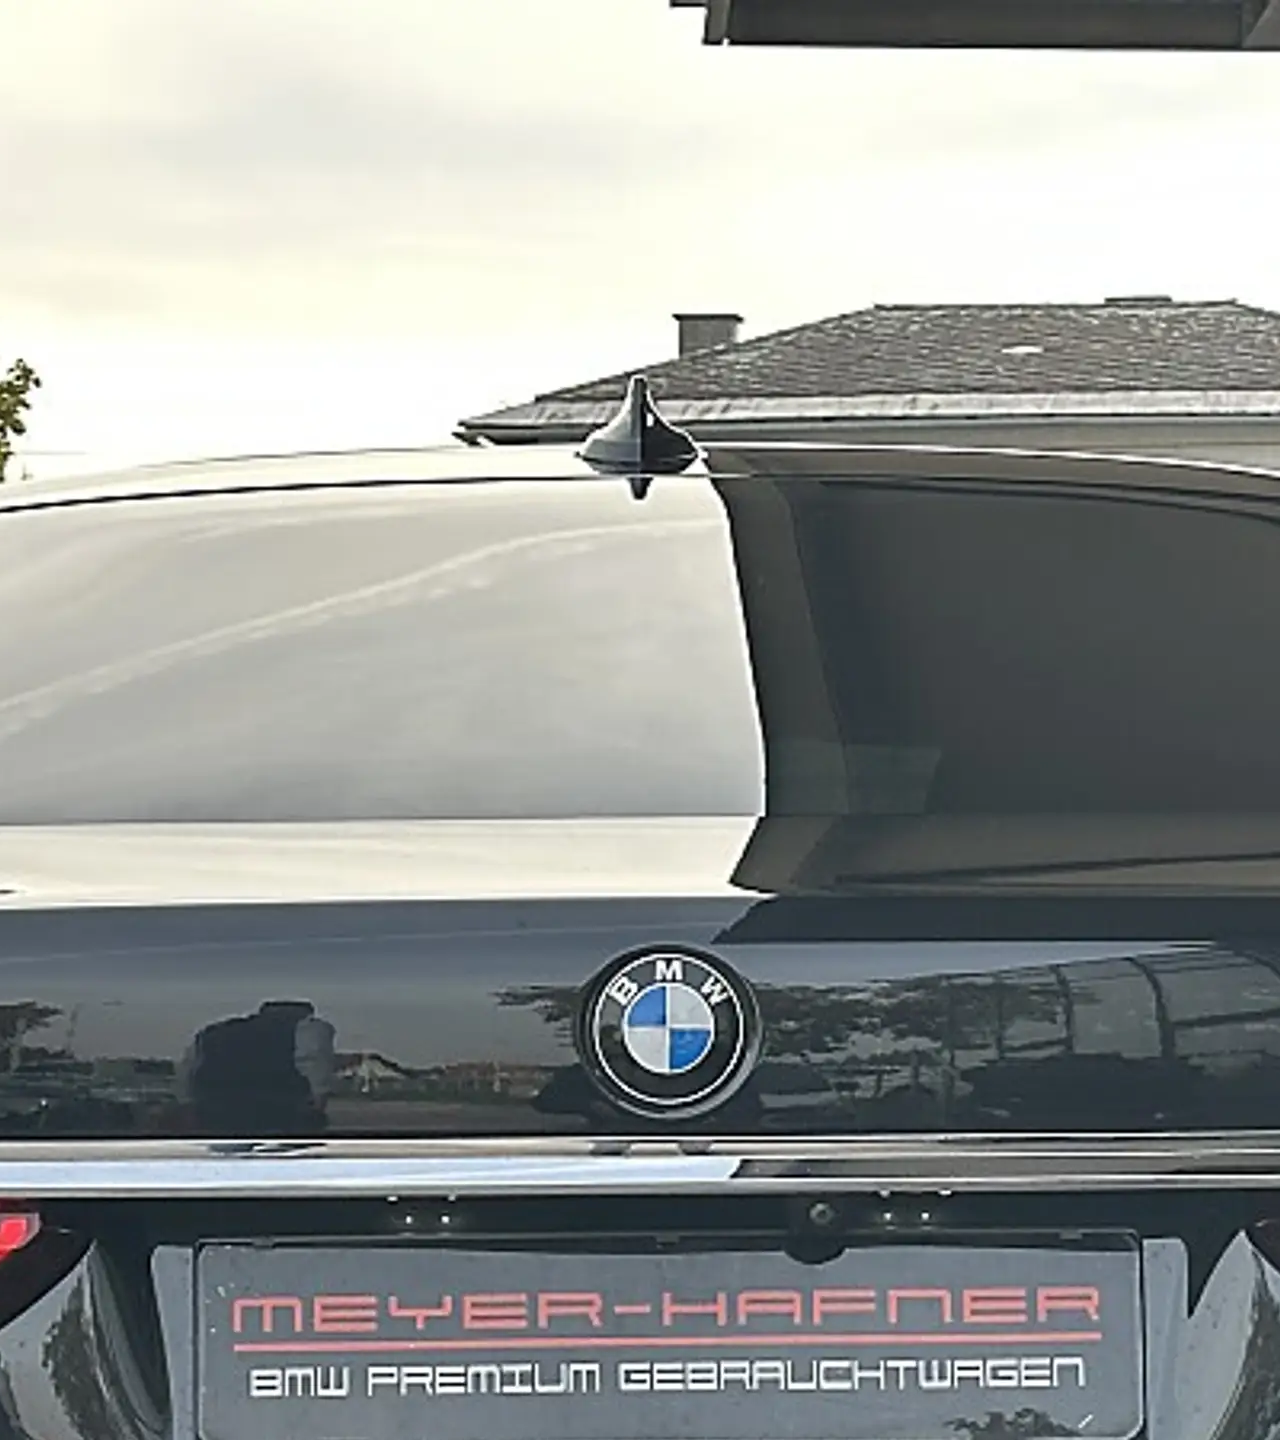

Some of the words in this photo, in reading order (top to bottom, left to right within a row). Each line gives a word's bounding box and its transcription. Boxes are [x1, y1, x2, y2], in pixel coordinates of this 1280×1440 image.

[608, 959, 729, 1006] BMW
[232, 1286, 1100, 1333] MEYER-HAFNER
[250, 1365, 350, 1397] BMW
[367, 1362, 601, 1397] PREMIUM
[619, 1356, 1086, 1394] GEBRAUCHTWAGEN
